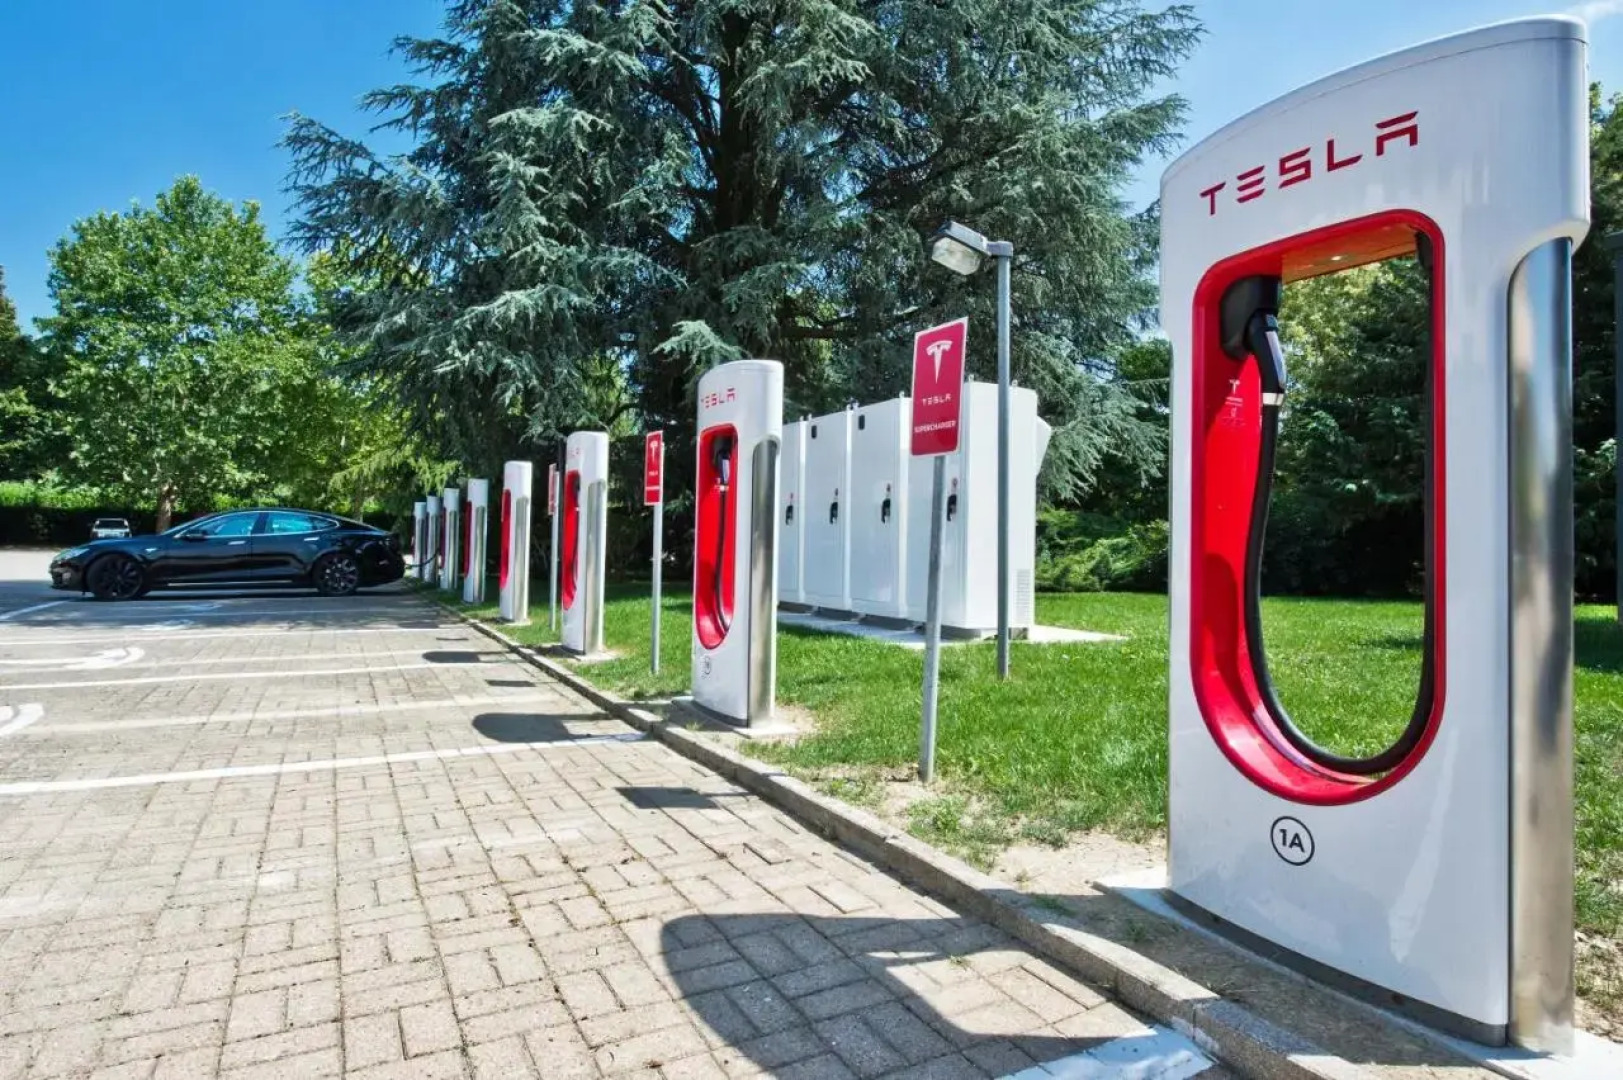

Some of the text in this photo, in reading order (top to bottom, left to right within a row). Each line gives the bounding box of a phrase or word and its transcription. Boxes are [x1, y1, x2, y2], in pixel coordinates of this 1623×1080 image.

[1200, 111, 1419, 216] TESLA
[922, 393, 951, 406] TESLA
[1279, 828, 1305, 853] 1A
